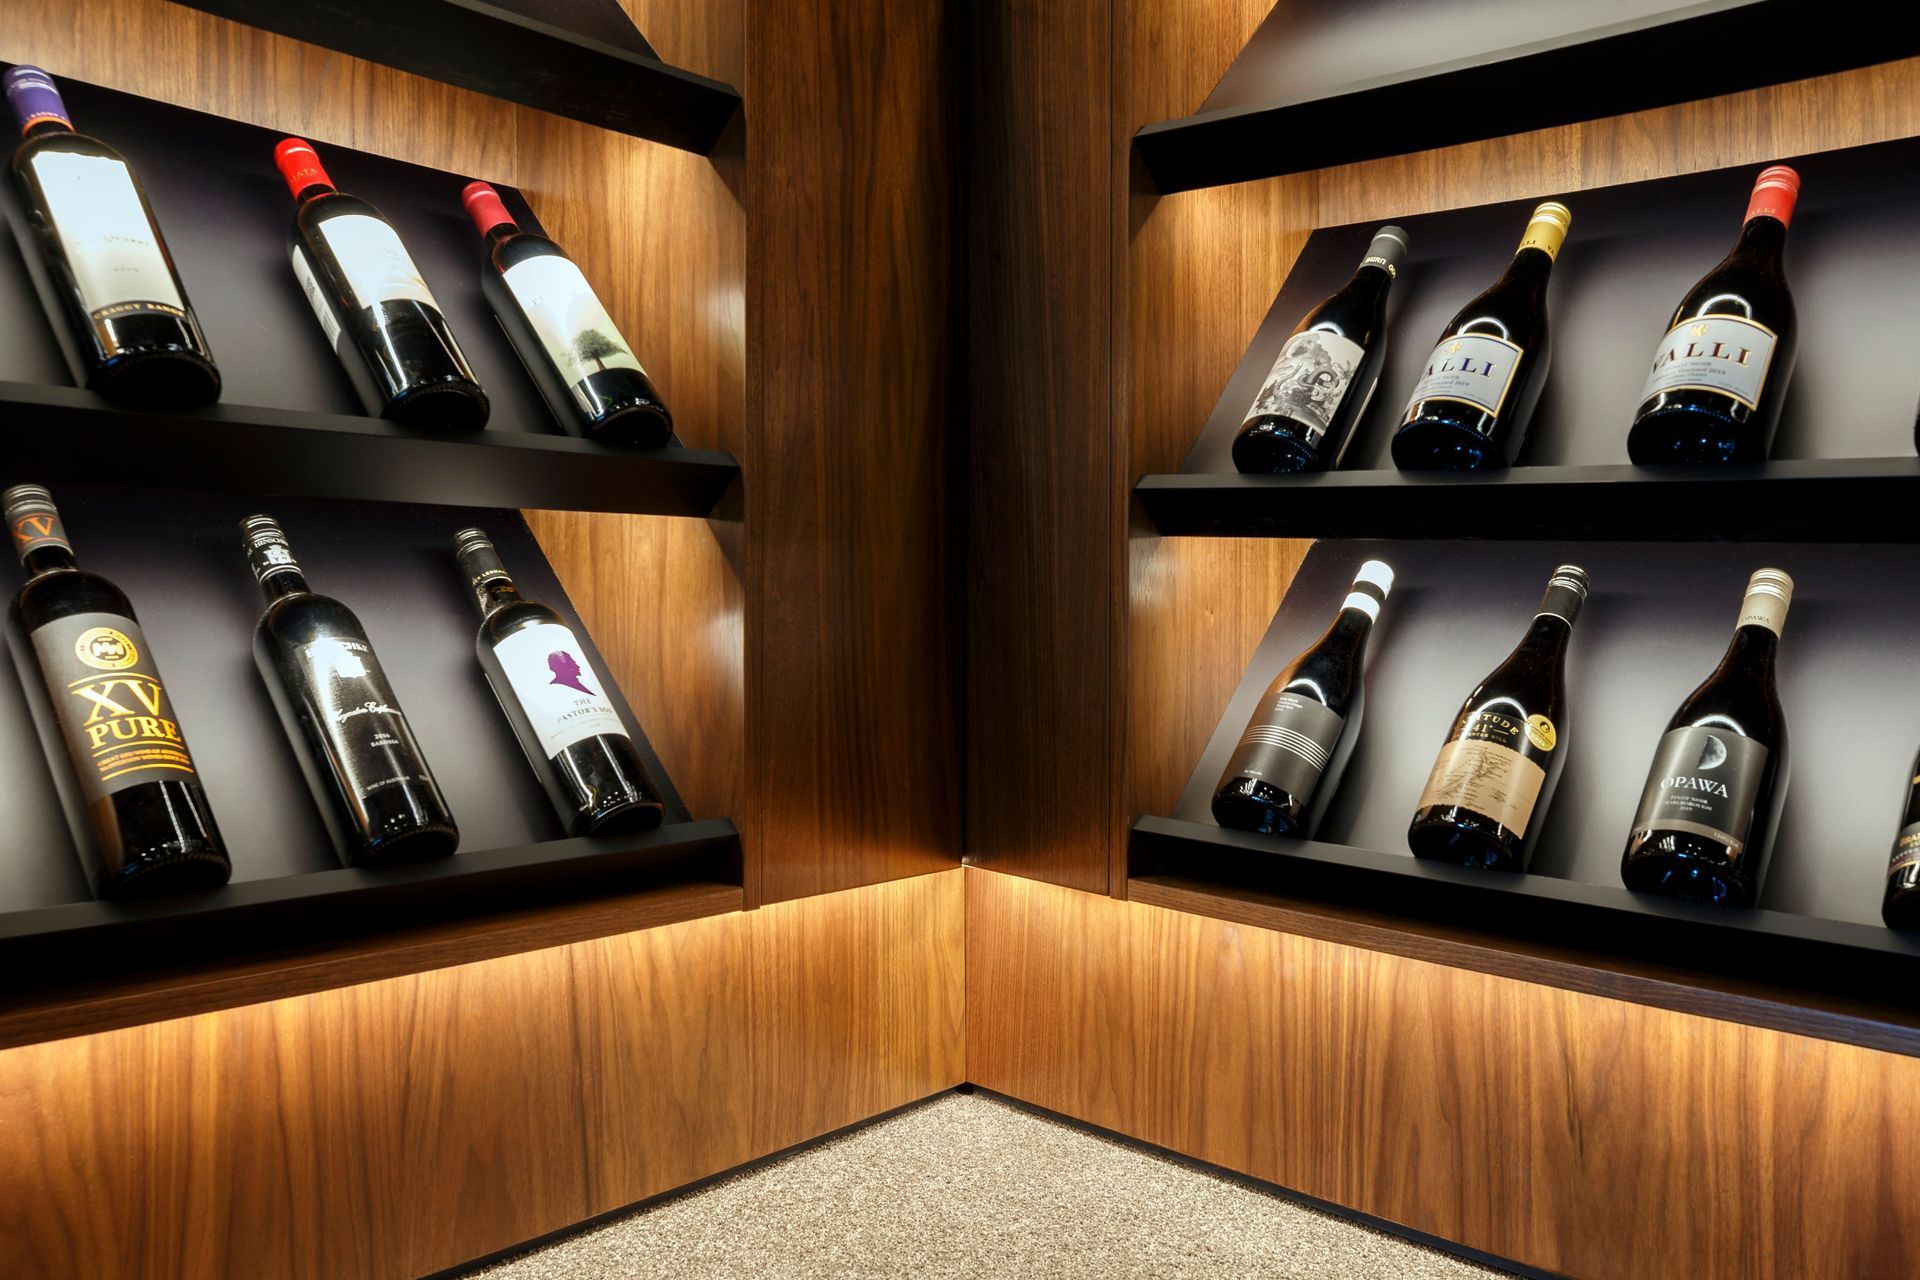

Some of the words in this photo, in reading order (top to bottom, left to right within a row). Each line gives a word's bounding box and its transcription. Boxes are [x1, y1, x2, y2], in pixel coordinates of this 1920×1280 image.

[1652, 341, 1752, 374] VALLI
[71, 679, 162, 727] XV
[84, 716, 182, 750] PURE
[1660, 775, 1729, 799] OPAWA
